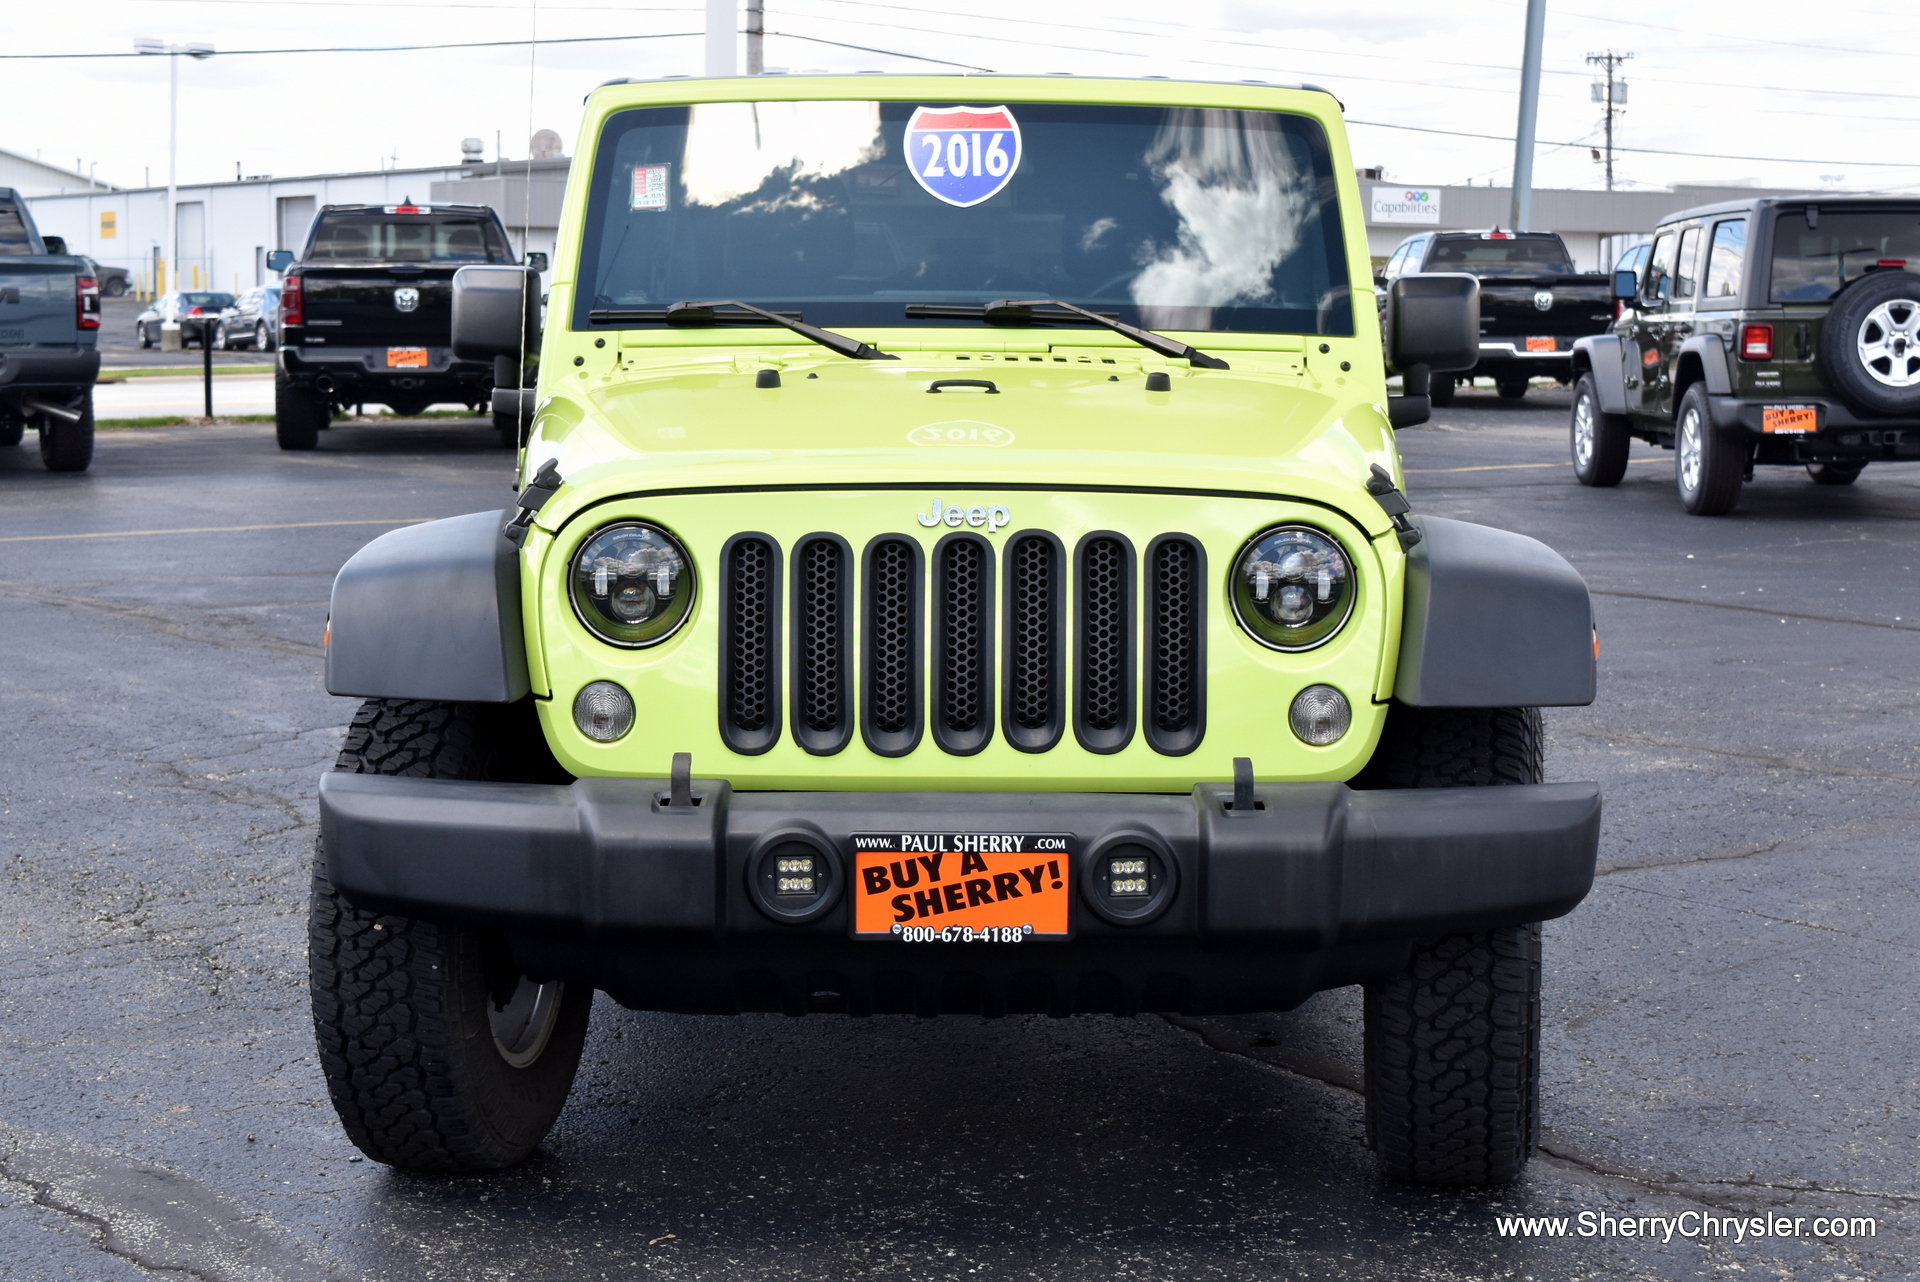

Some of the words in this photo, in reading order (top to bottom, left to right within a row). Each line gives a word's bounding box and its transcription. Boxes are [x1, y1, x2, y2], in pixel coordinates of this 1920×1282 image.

[921, 133, 1009, 177] 2016
[1373, 200, 1437, 218] Capabilities
[1765, 409, 1785, 421] BUY
[1772, 411, 1814, 428] SHERRY!
[917, 498, 1010, 533] Jeep
[901, 835, 948, 852] PAUL
[953, 835, 1025, 852] SHERRY
[1034, 838, 1066, 849] .COM
[862, 853, 943, 895] BUY
[960, 852, 988, 876] A
[891, 860, 1063, 923] SHERRY!
[902, 926, 1023, 943] 800-678-4188
